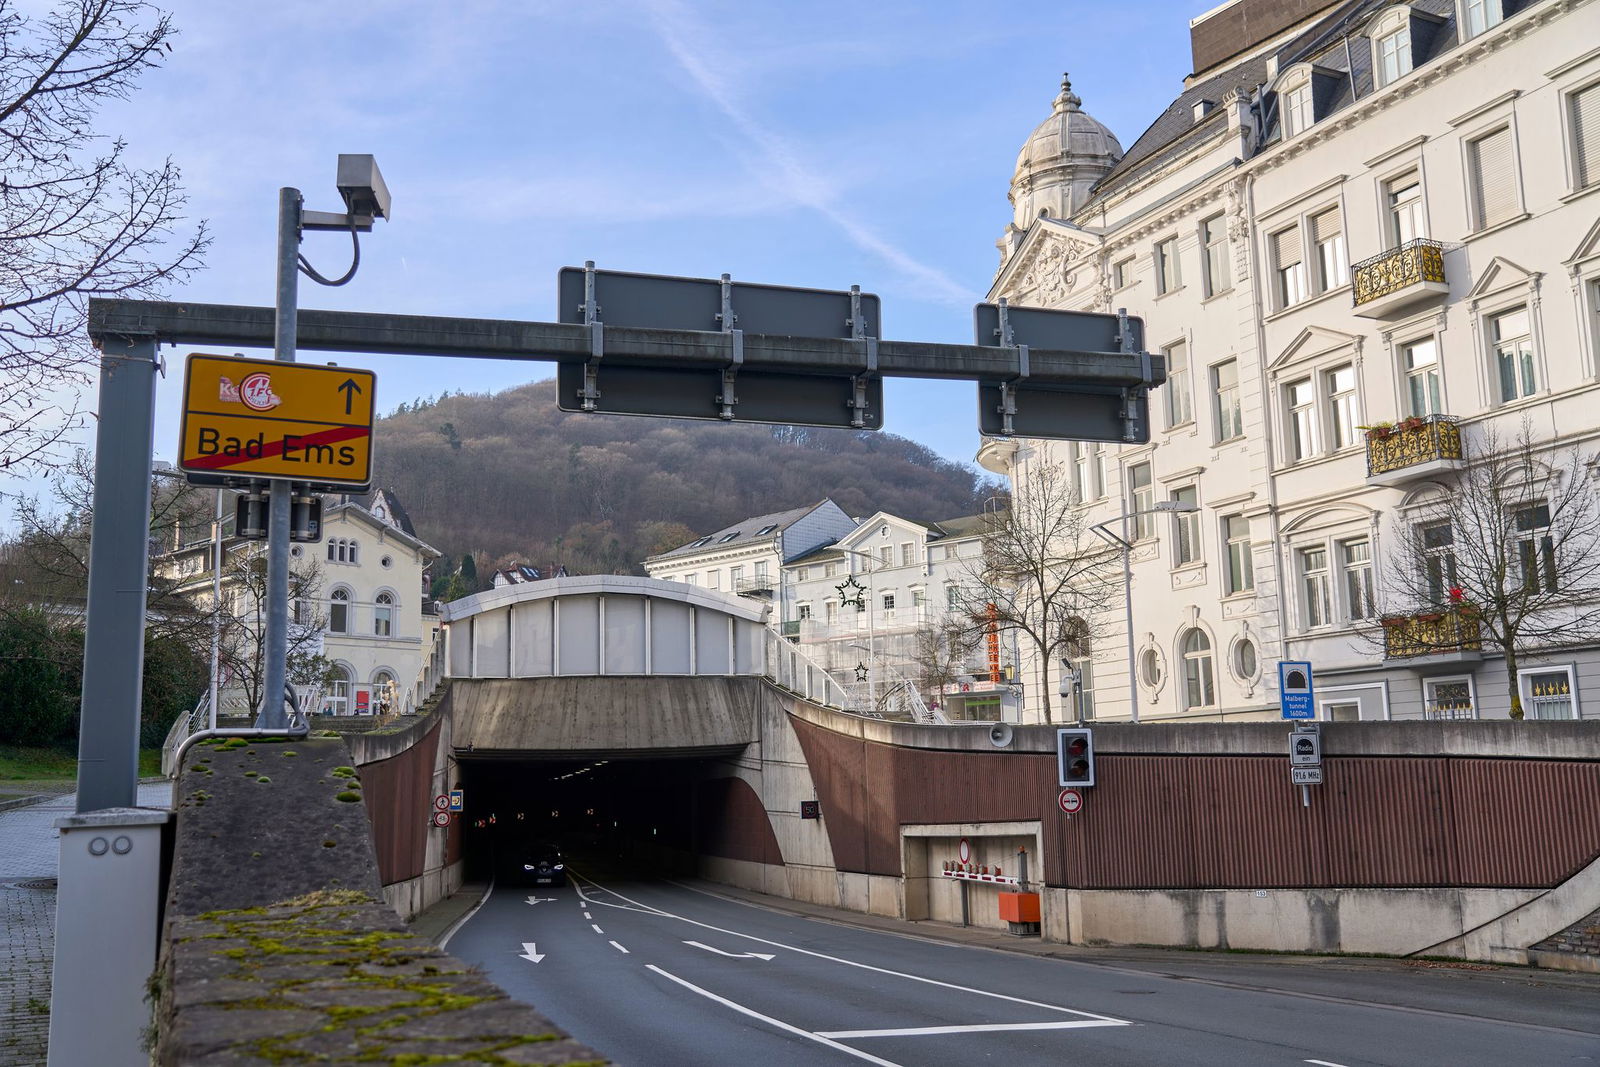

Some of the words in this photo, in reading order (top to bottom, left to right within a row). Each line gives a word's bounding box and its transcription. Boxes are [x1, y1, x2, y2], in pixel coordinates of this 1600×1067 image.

[198, 427, 264, 459] Bad
[282, 434, 355, 466] Ems
[1308, 771, 1319, 779] MHz
